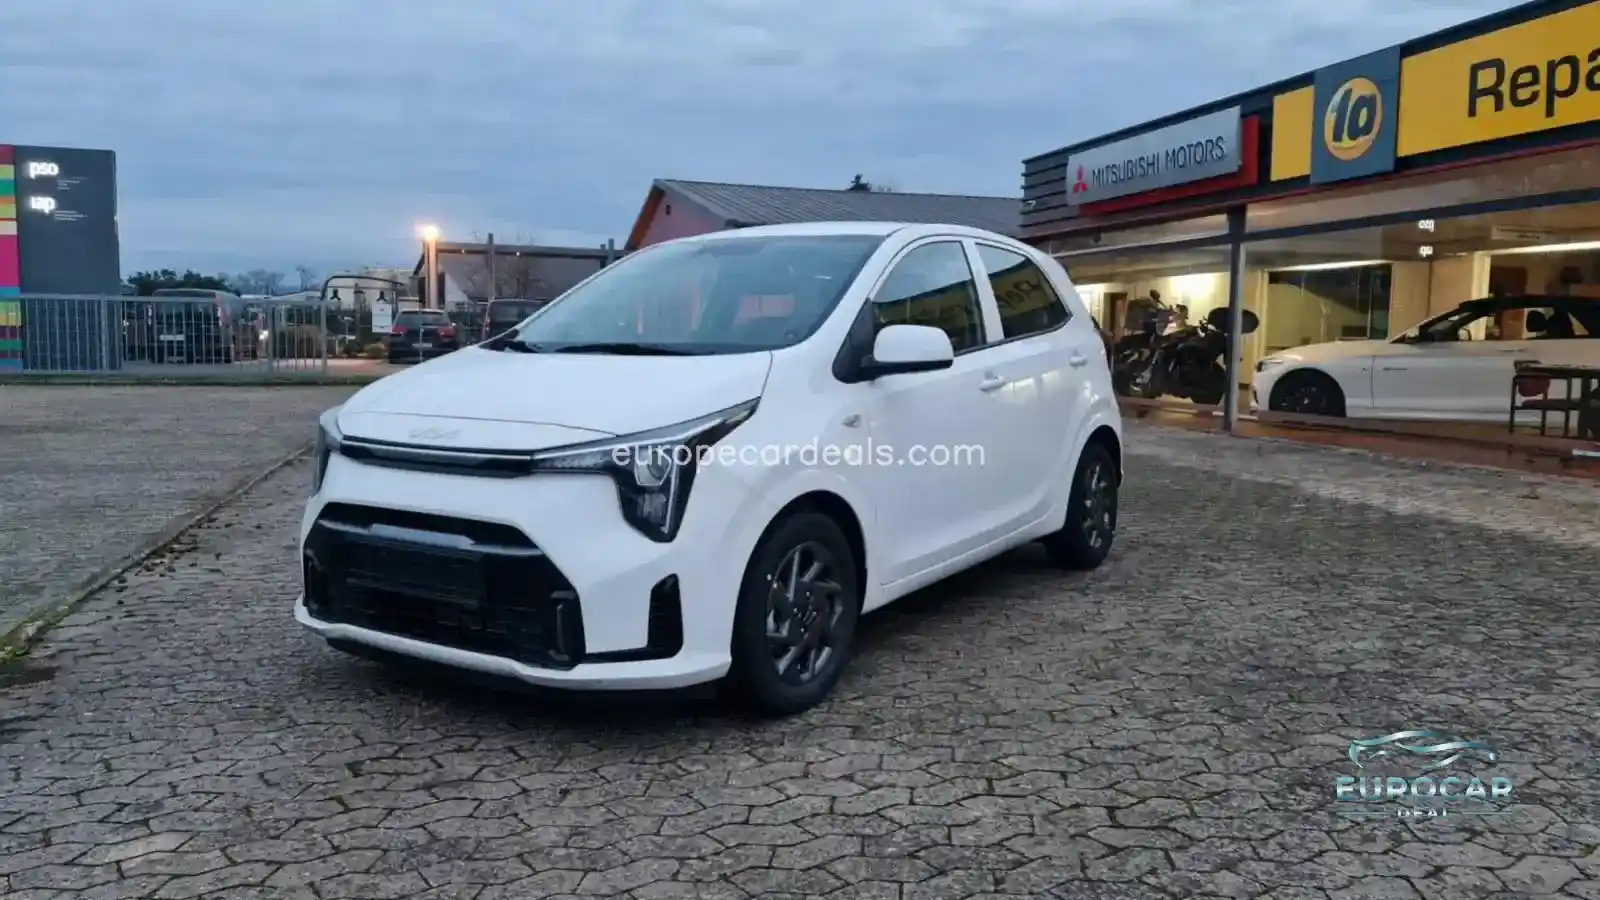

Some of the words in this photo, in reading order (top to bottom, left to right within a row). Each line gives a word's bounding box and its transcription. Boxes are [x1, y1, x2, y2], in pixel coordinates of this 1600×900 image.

[1467, 46, 1600, 118] Repa
[29, 161, 59, 180] pso
[1091, 153, 1160, 188] MITSUBISHI
[1165, 135, 1226, 171] MOTORS
